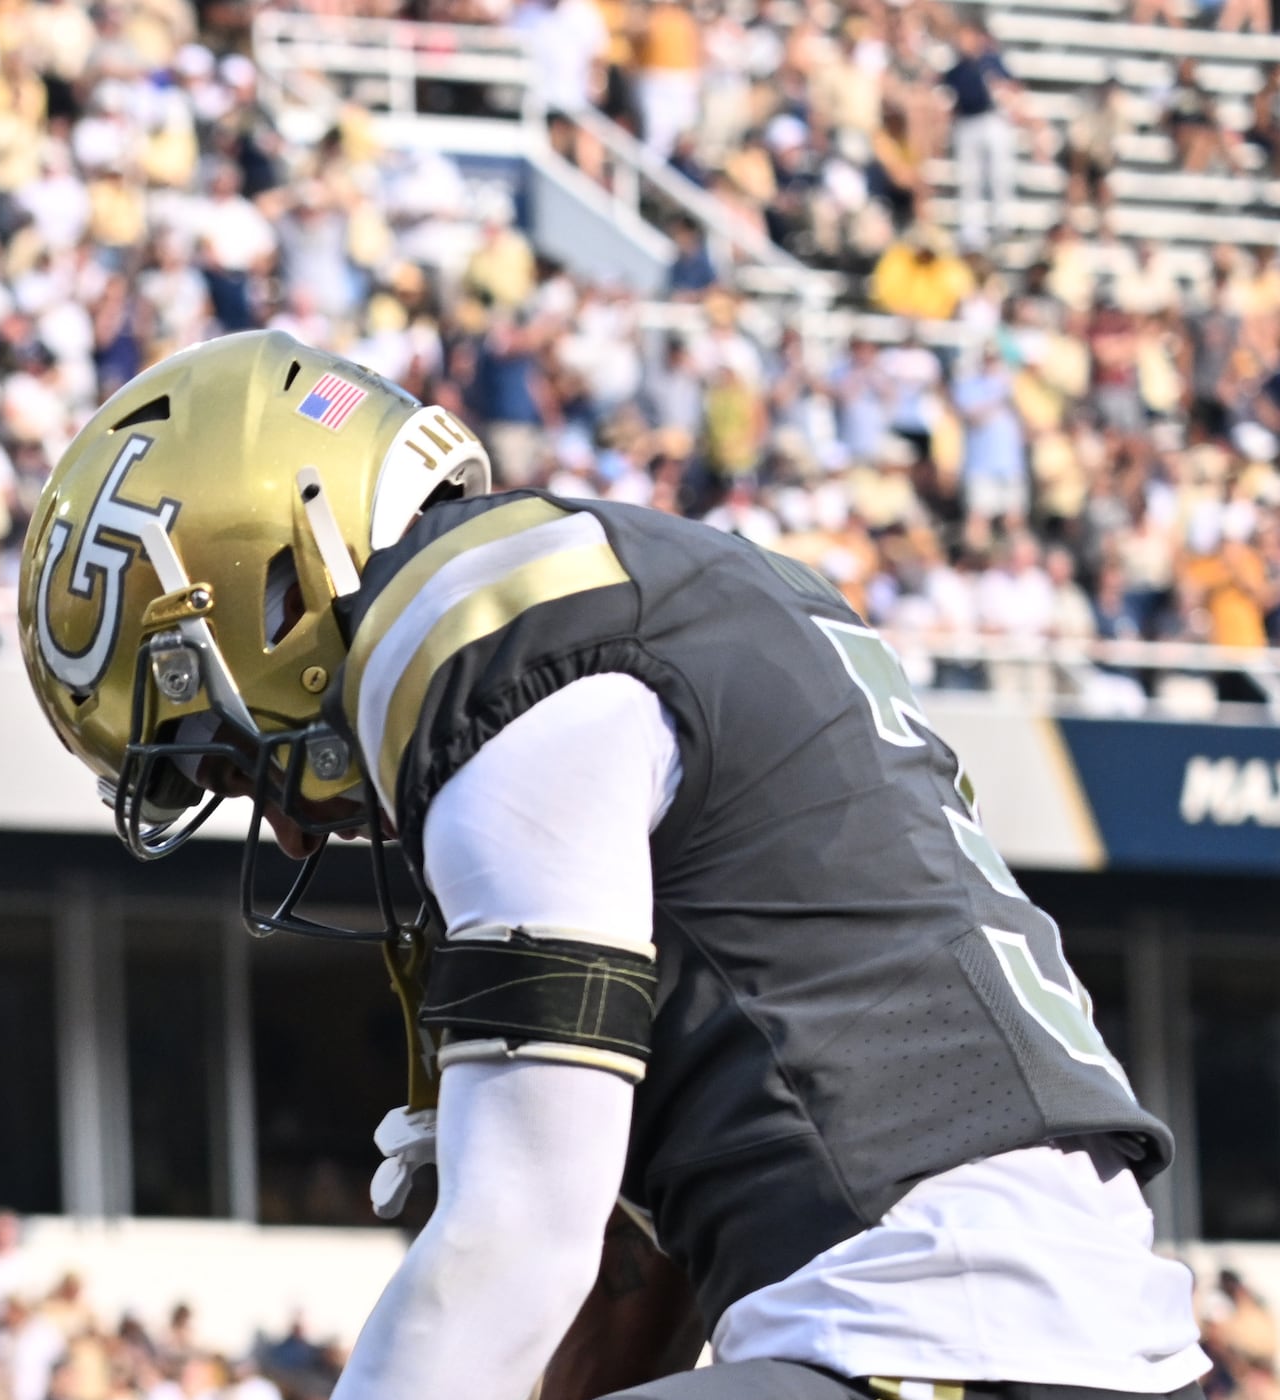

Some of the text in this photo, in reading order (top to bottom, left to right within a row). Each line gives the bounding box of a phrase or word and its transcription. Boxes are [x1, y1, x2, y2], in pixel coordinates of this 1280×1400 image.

[404, 412, 478, 470] JAC
[37, 433, 181, 691] GT
[1180, 755, 1280, 828] MA
